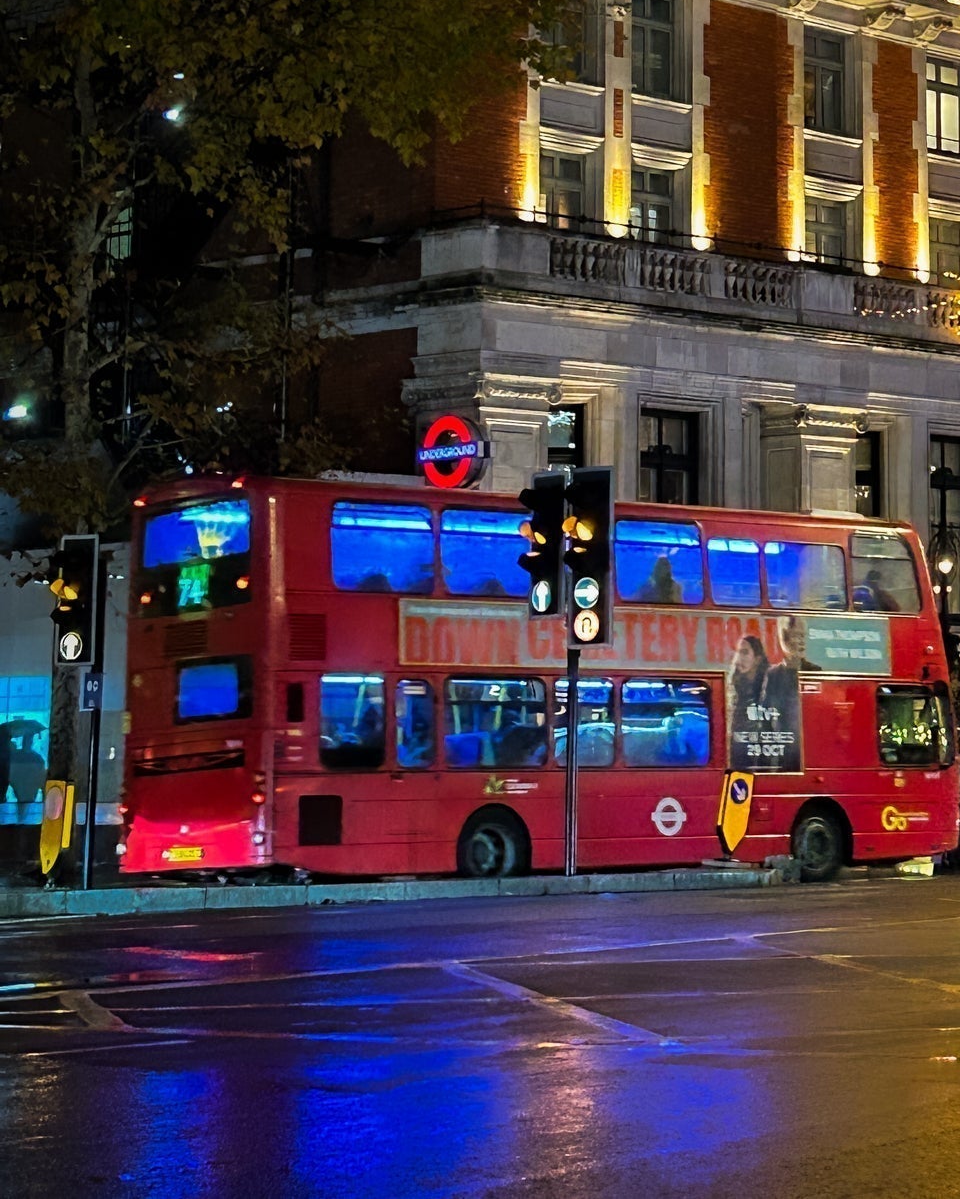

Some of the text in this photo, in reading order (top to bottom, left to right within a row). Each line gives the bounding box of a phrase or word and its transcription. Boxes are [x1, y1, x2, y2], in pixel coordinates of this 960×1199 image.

[418, 443, 476, 461] UNDERGROUND
[178, 578, 205, 607] 74
[405, 616, 520, 666] DOWN
[527, 612, 699, 662] CETERY
[760, 731, 796, 744] SERIES
[762, 744, 785, 757] OCT
